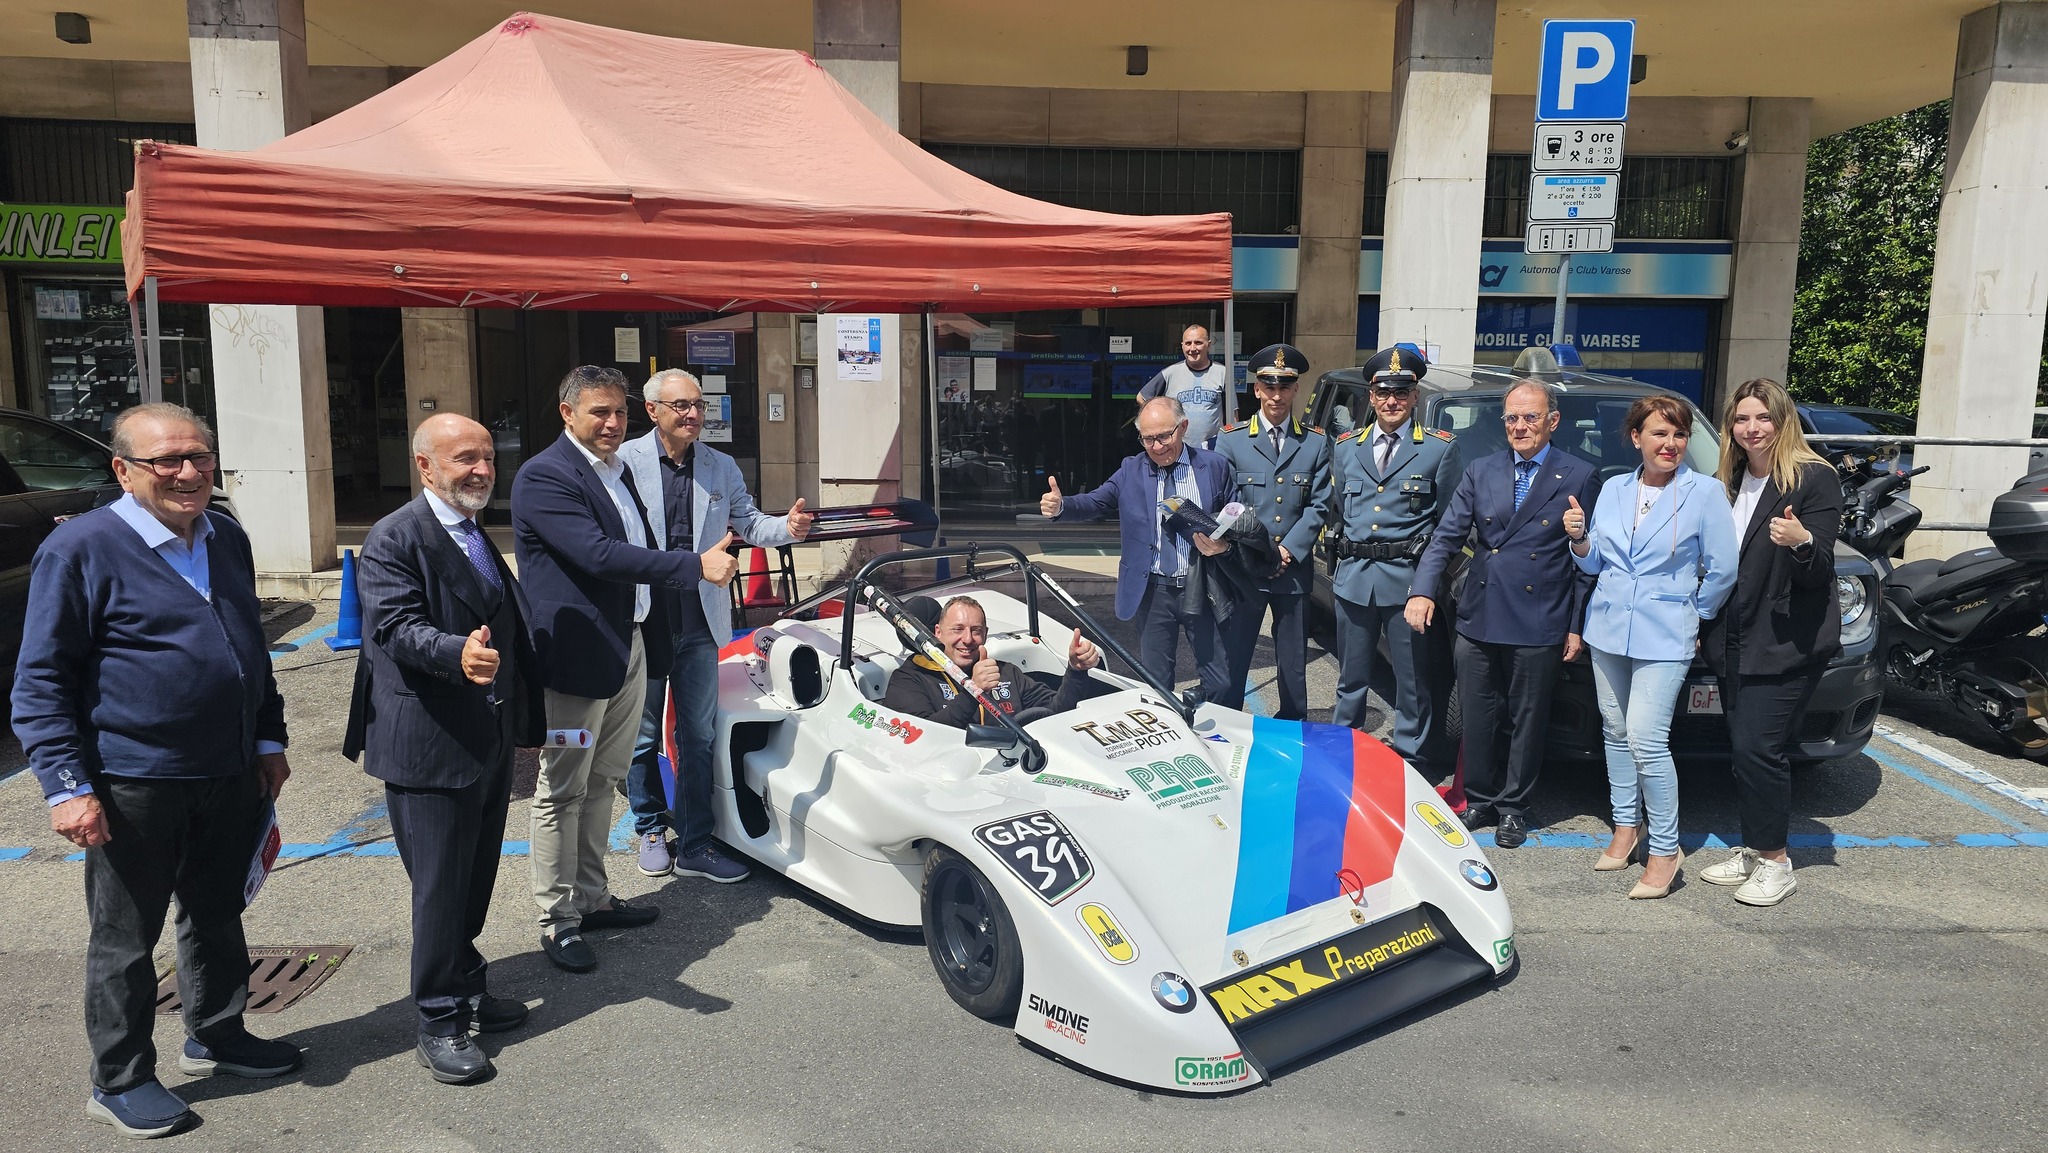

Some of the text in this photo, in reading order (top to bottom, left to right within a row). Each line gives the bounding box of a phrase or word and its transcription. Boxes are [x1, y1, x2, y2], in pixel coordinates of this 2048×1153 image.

[1557, 31, 1616, 111] P
[1574, 130, 1615, 143] 3 ore
[1588, 147, 1594, 155] 8
[1519, 265, 1632, 275] Automoe Club Varese
[1534, 333, 1574, 347] CLB
[1581, 334, 1641, 348] VARESE
[1952, 597, 1989, 614] TMAX
[1105, 729, 1182, 761] MECCANICA PIOTTI
[1105, 741, 1134, 753] TORNERIA
[1125, 753, 1215, 793] PRM
[1156, 784, 1231, 811] PRODUZIONE RACCORDI
[1180, 795, 1222, 811] MORAZZONE
[985, 815, 1058, 847] GAS
[1015, 836, 1081, 891] 39
[1209, 922, 1437, 1025] MAX Preparazioni
[1027, 993, 1090, 1034] SIMONE
[1050, 1019, 1086, 1045] RACING
[1181, 1059, 1245, 1080] ORAM
[1191, 1078, 1238, 1086] SOSPENSIONI
